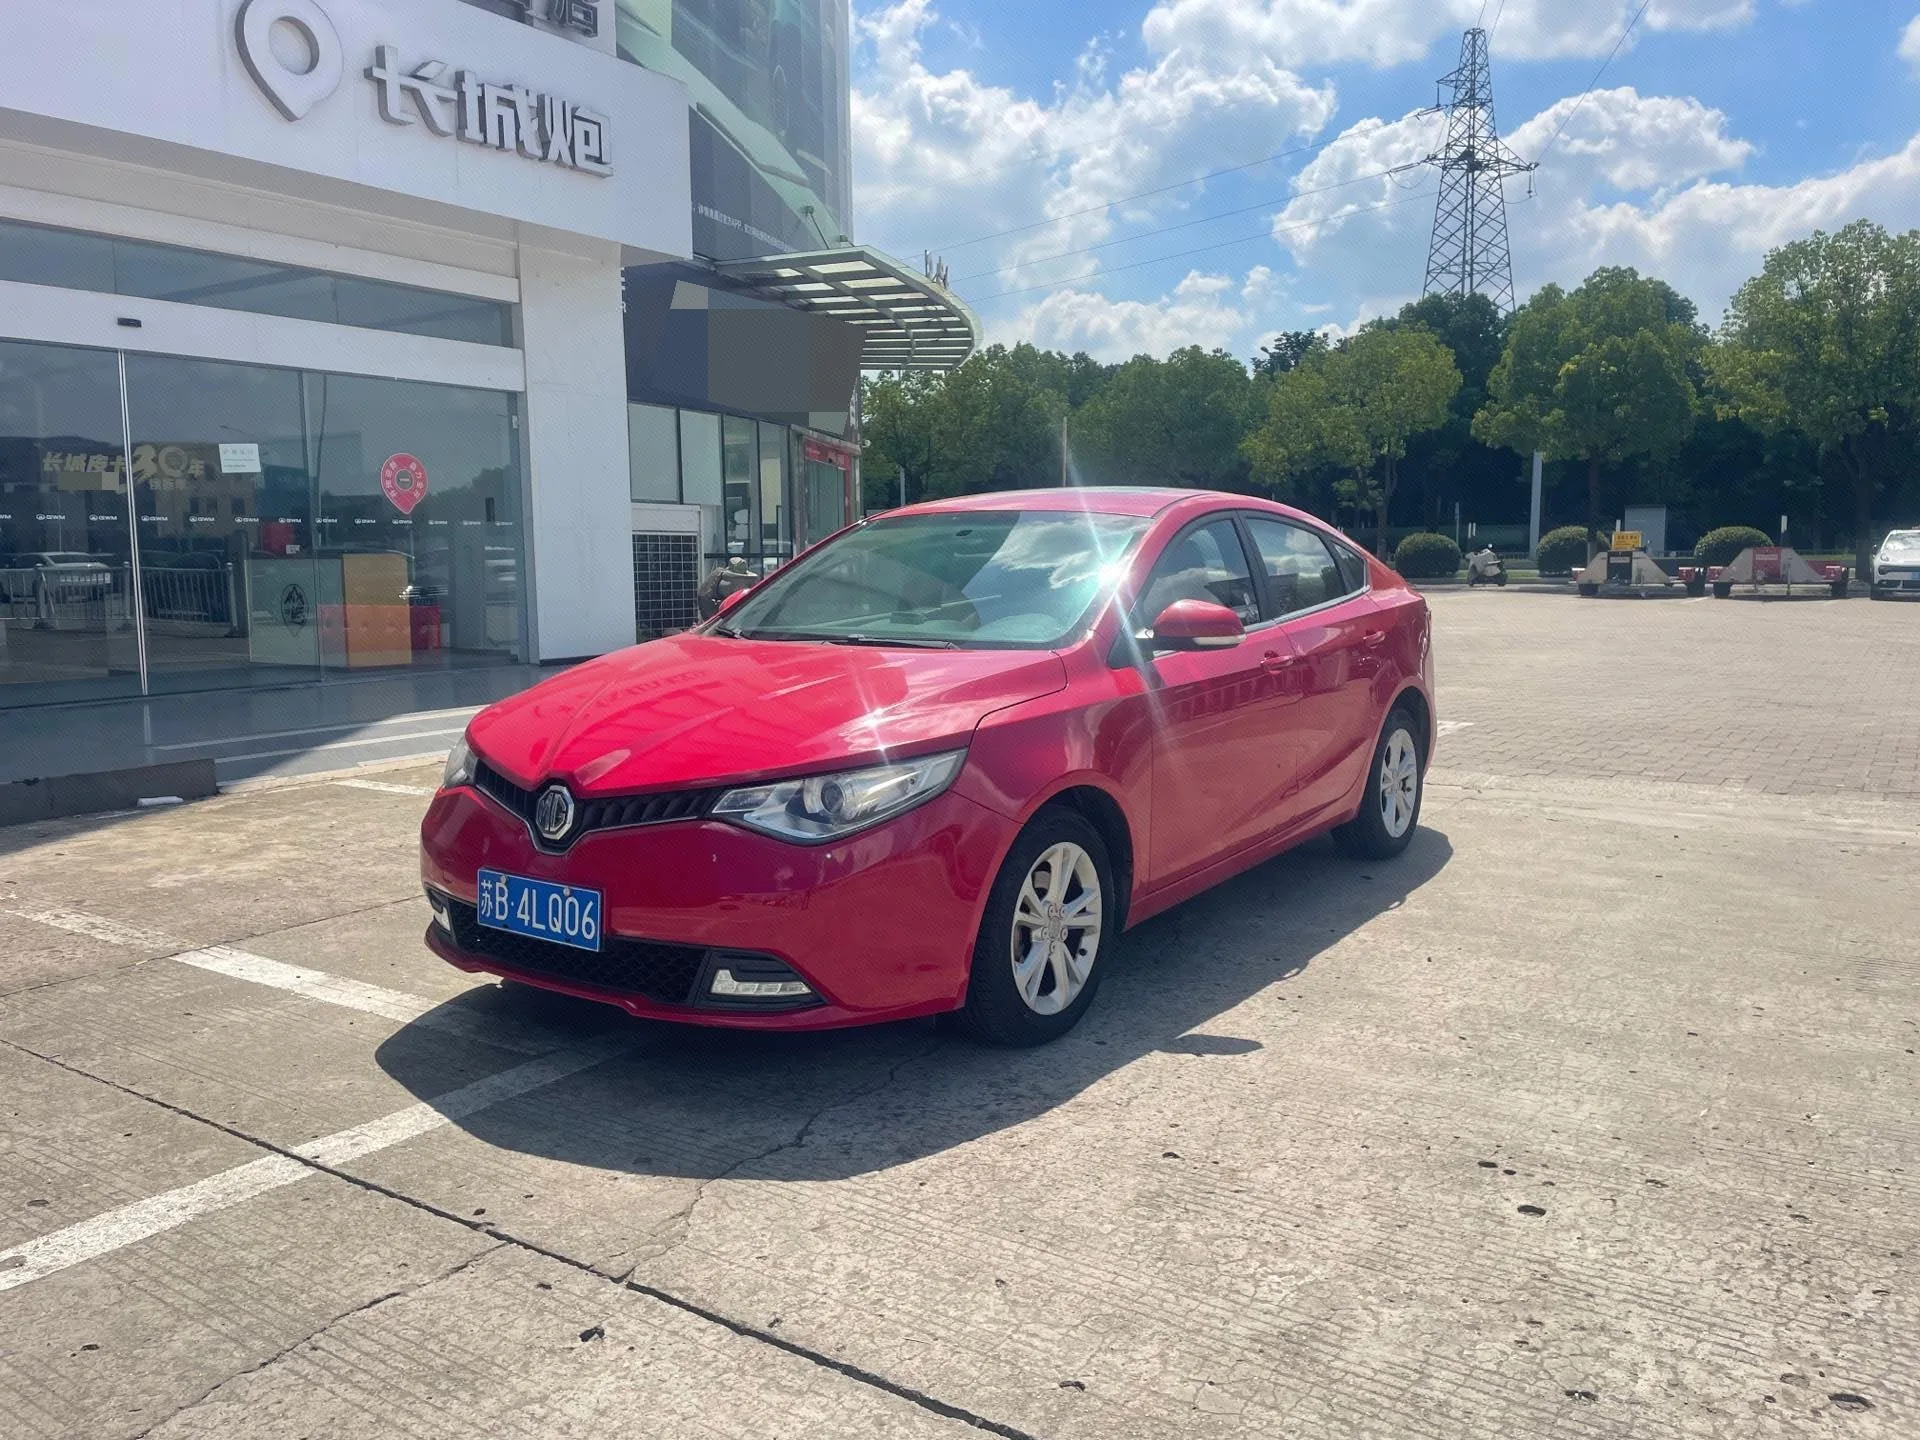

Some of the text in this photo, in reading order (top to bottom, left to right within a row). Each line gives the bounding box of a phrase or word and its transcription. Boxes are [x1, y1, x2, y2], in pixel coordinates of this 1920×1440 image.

[364, 44, 614, 178] 长城炮
[537, 791, 568, 833] MG
[480, 879, 596, 940] 苏B·4LQ06
